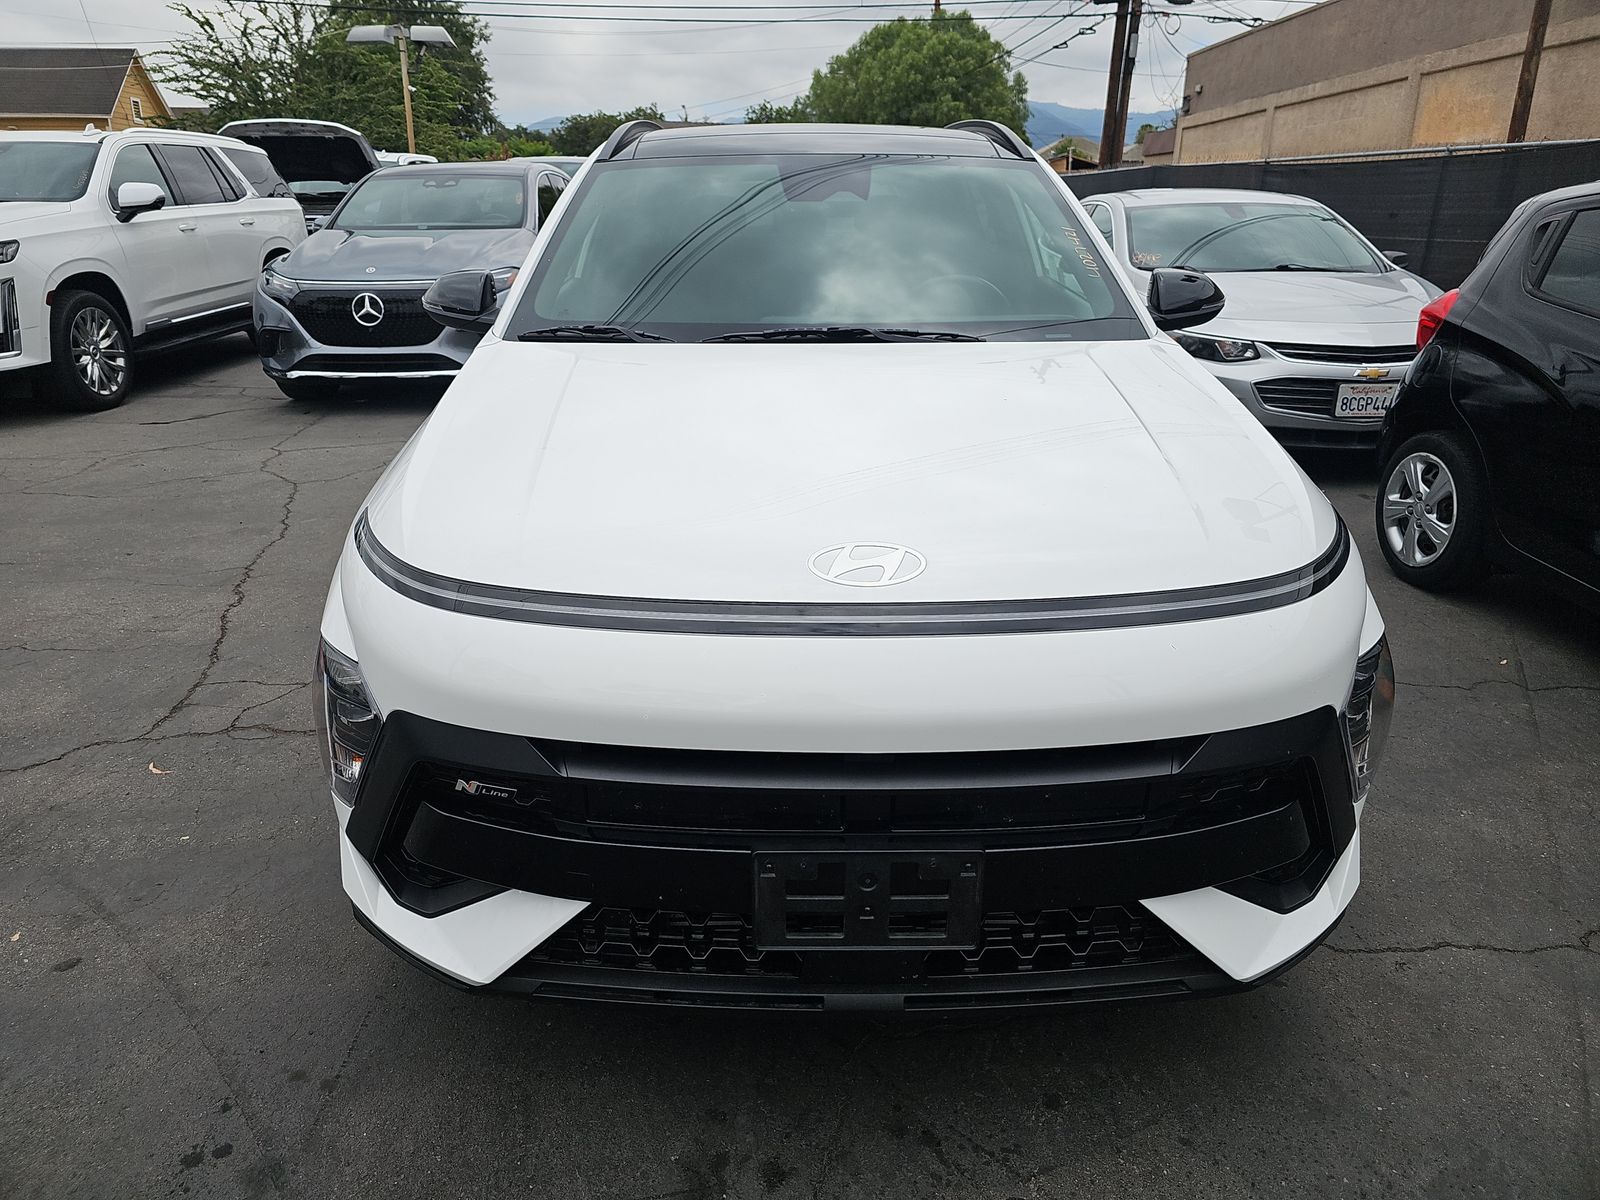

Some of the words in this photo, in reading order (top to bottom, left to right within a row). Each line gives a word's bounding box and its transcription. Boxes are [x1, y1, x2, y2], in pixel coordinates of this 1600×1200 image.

[1351, 386, 1390, 397] California
[1340, 396, 1391, 412] 8CGP44
[455, 778, 477, 794] N
[482, 788, 509, 798] Line
